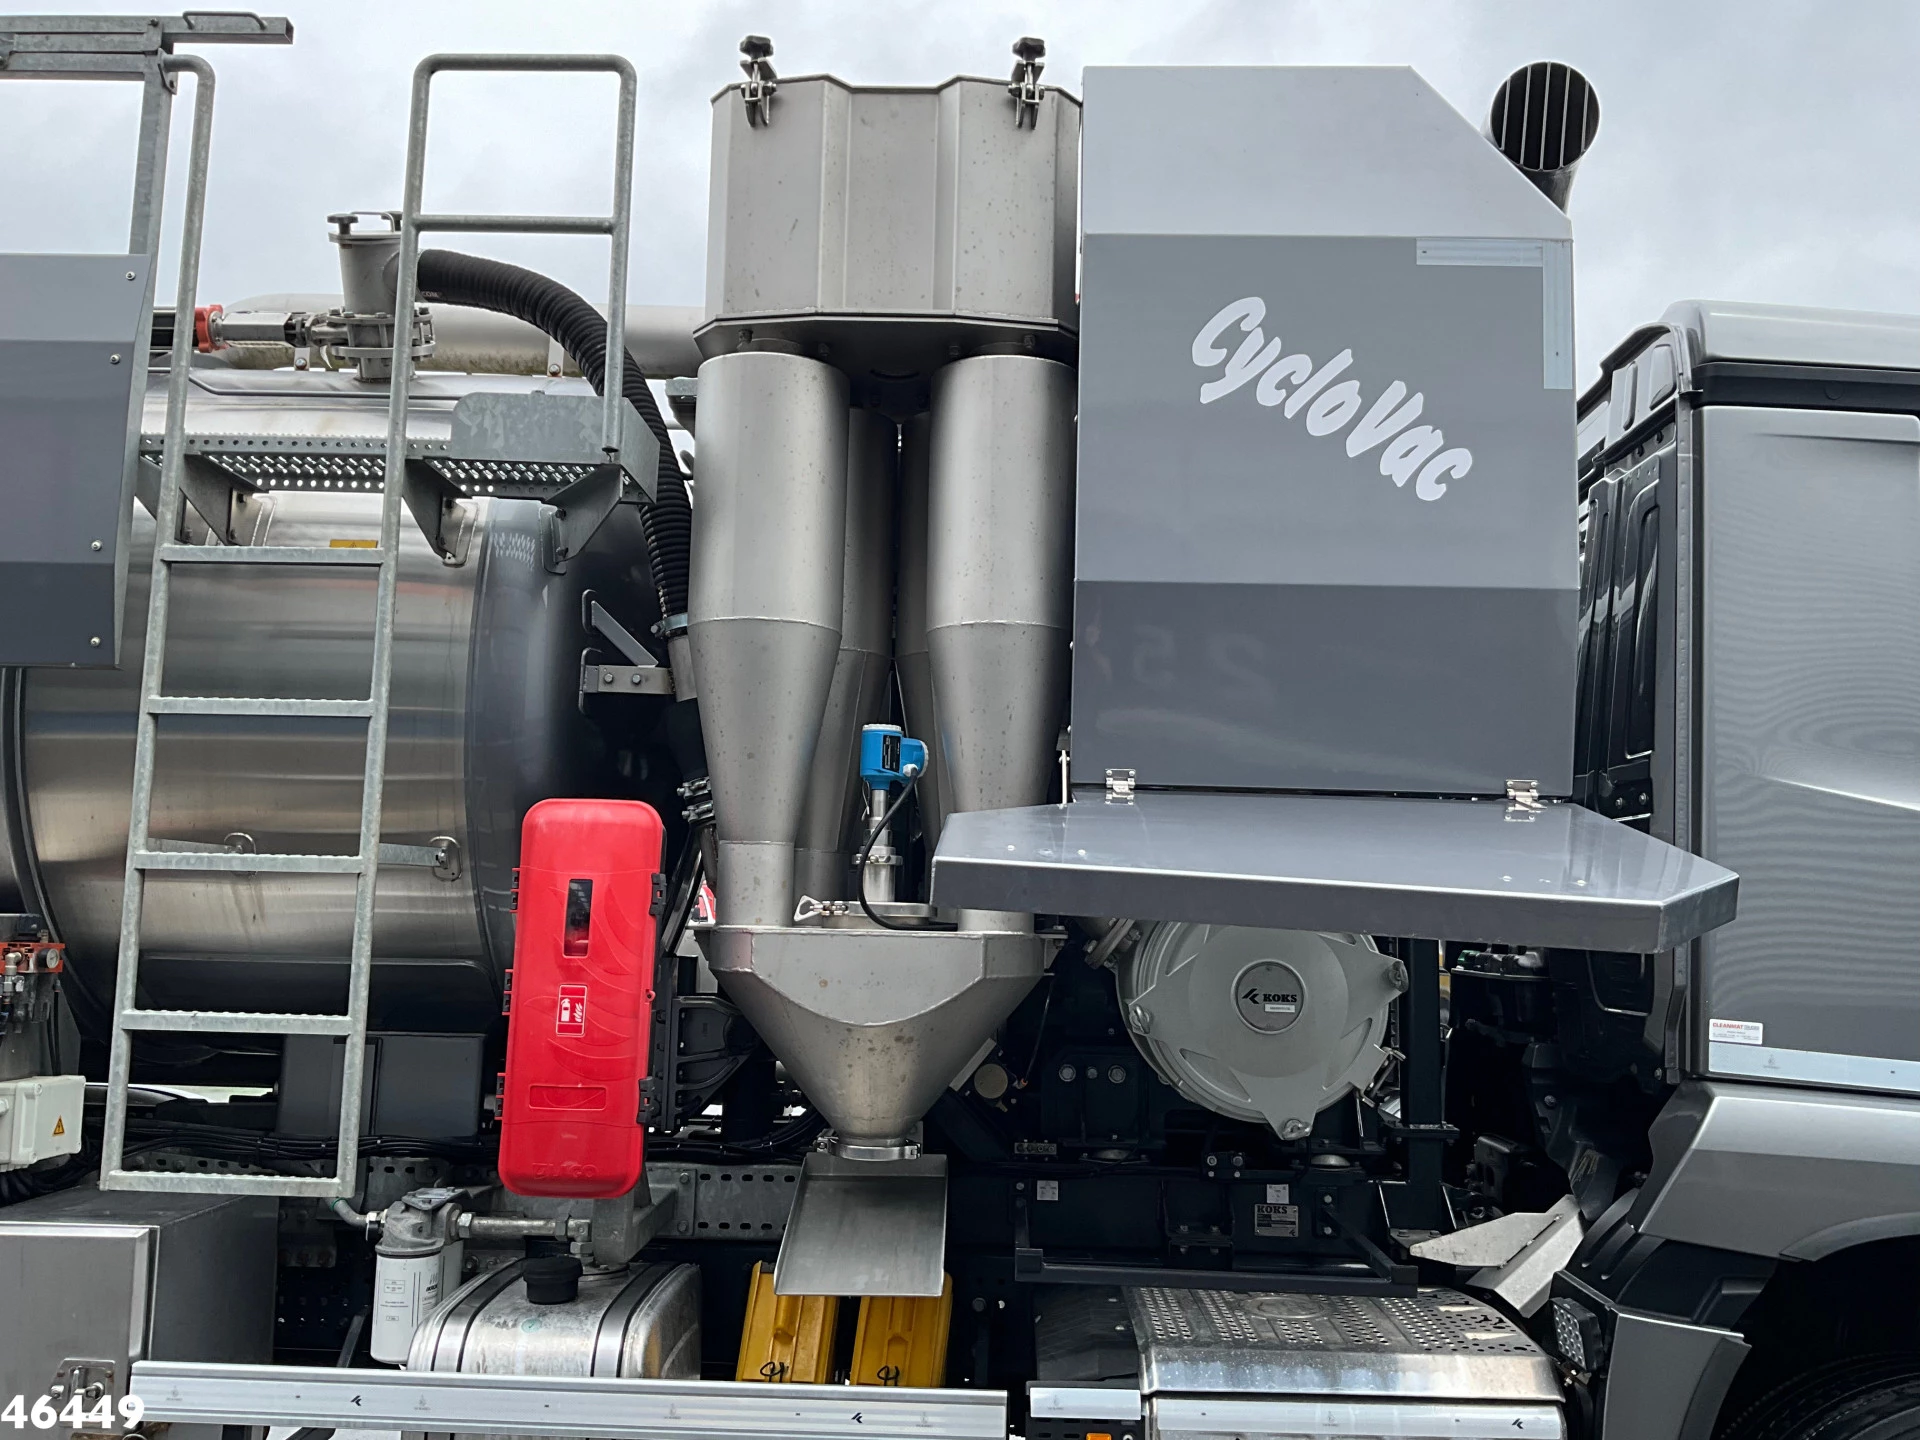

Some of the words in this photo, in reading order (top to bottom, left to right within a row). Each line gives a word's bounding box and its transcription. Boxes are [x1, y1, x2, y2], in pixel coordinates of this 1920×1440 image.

[1192, 297, 1473, 501] CycloVac
[1262, 993, 1298, 1003] KOKS
[1256, 1205, 1288, 1215] KOKS
